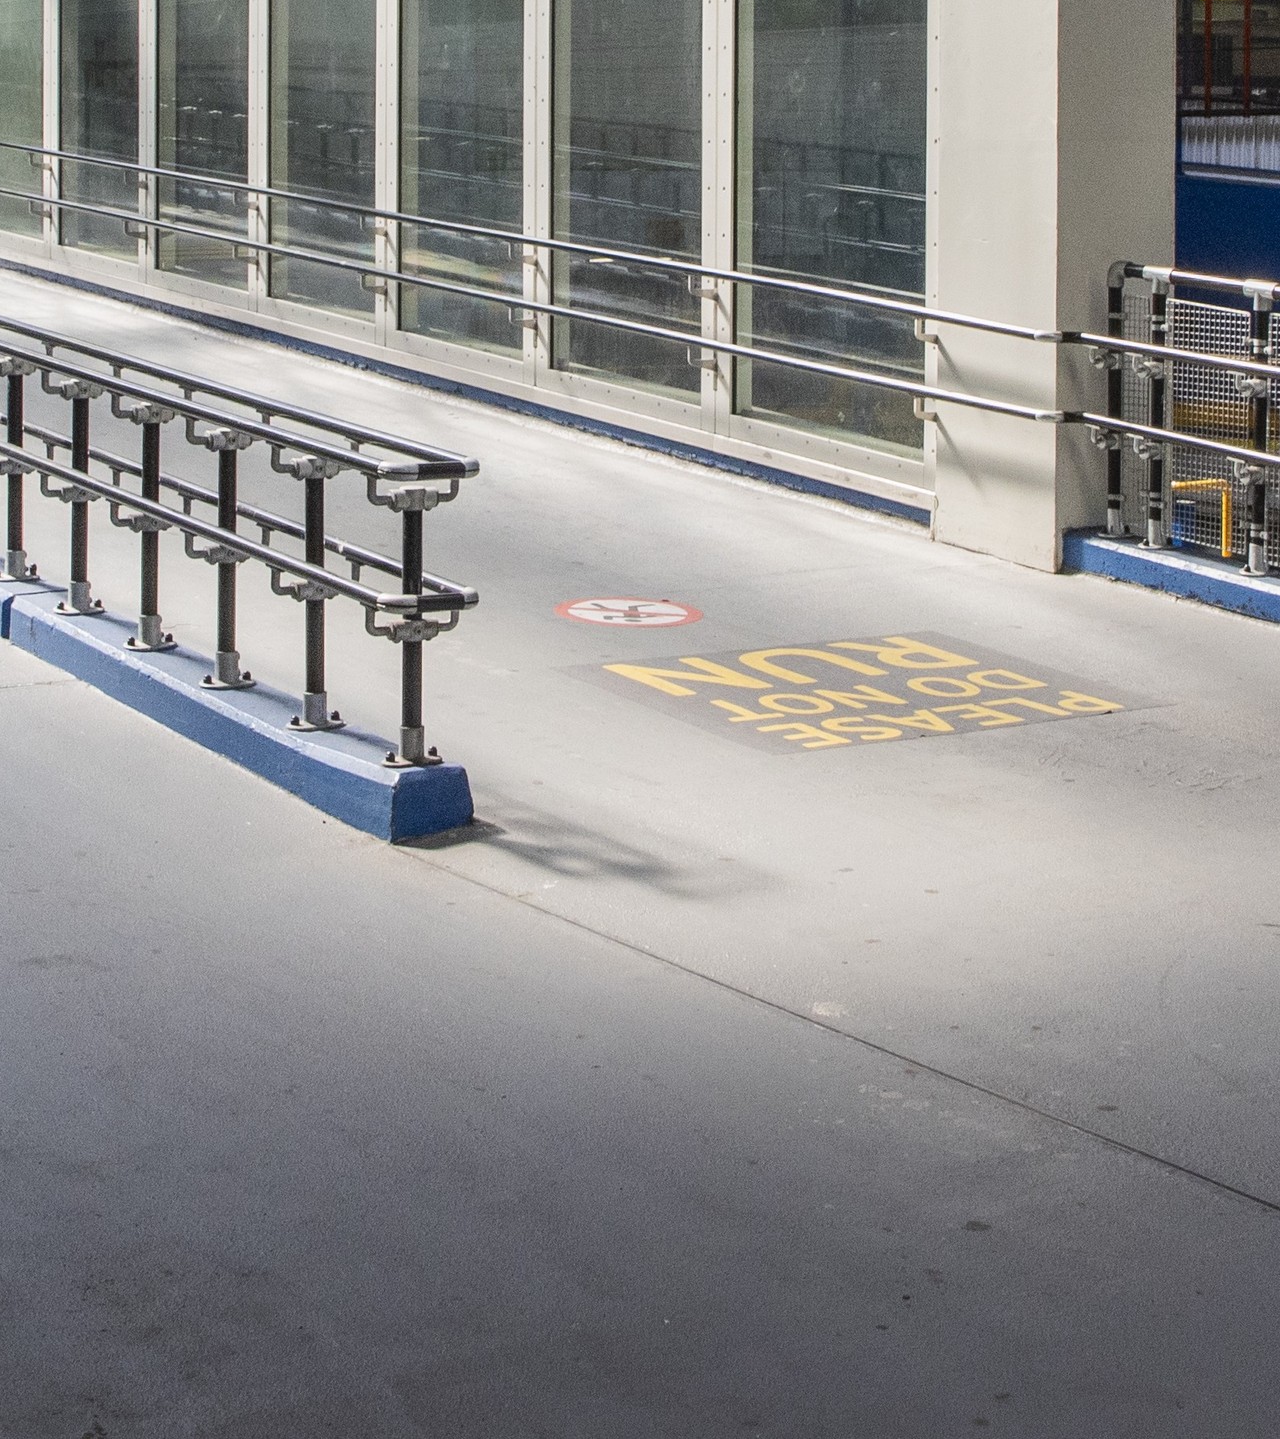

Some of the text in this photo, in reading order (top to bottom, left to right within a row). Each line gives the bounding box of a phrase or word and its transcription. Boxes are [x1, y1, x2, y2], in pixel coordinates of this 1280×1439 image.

[602, 636, 980, 697] RUN
[710, 669, 1048, 723] DO NOT
[756, 690, 1125, 749] PLEASE
